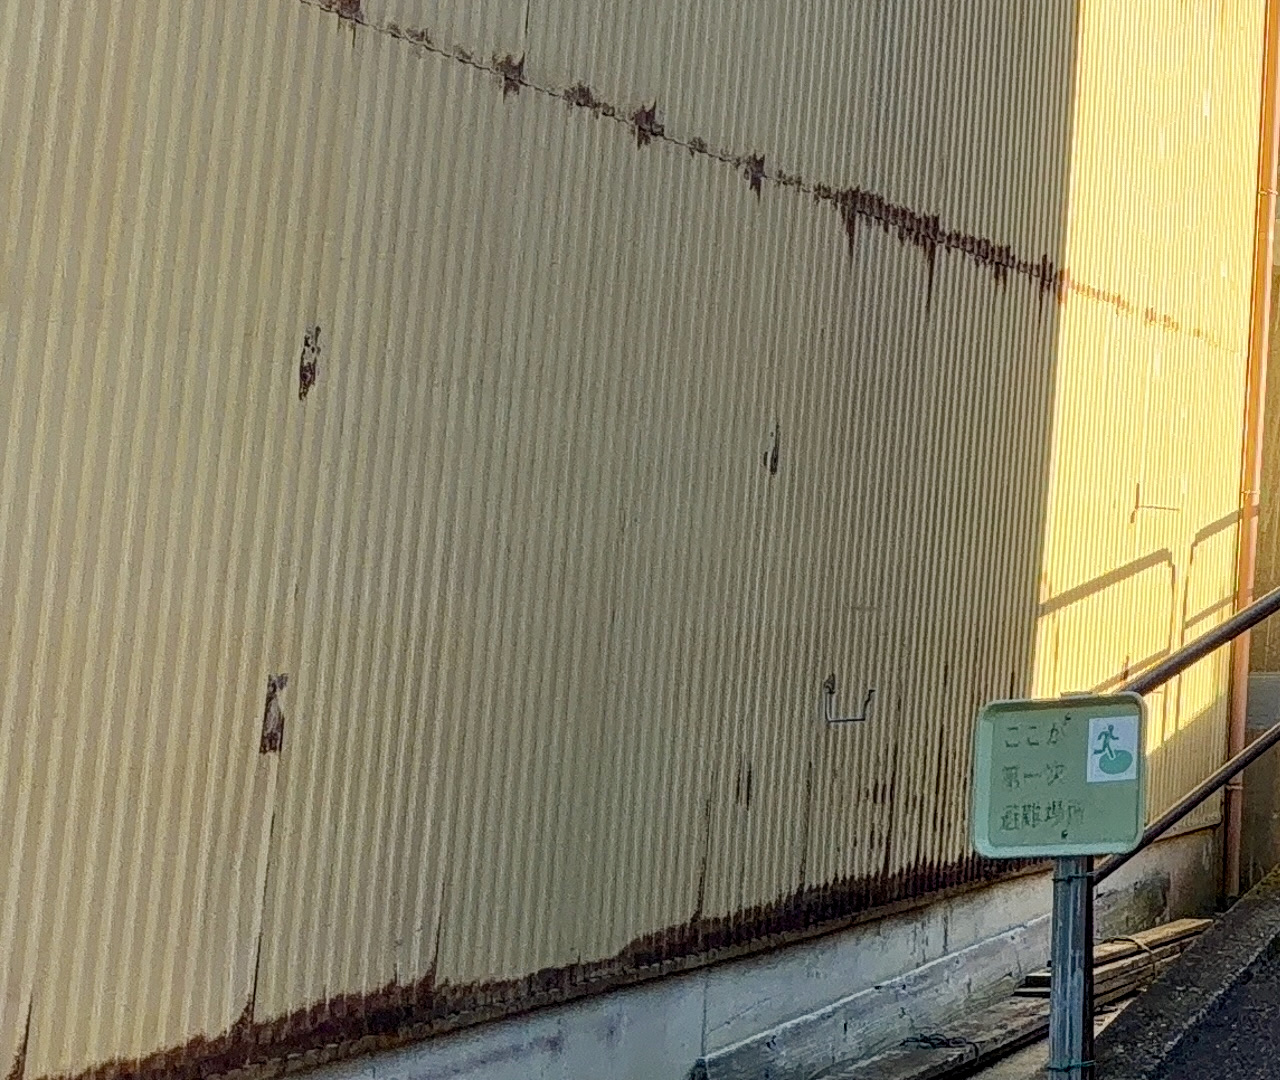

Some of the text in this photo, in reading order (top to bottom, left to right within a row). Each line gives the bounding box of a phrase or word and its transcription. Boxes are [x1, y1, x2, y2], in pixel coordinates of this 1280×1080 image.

[1004, 721, 1067, 748] ここが
[1000, 798, 1085, 832] 避難場所
